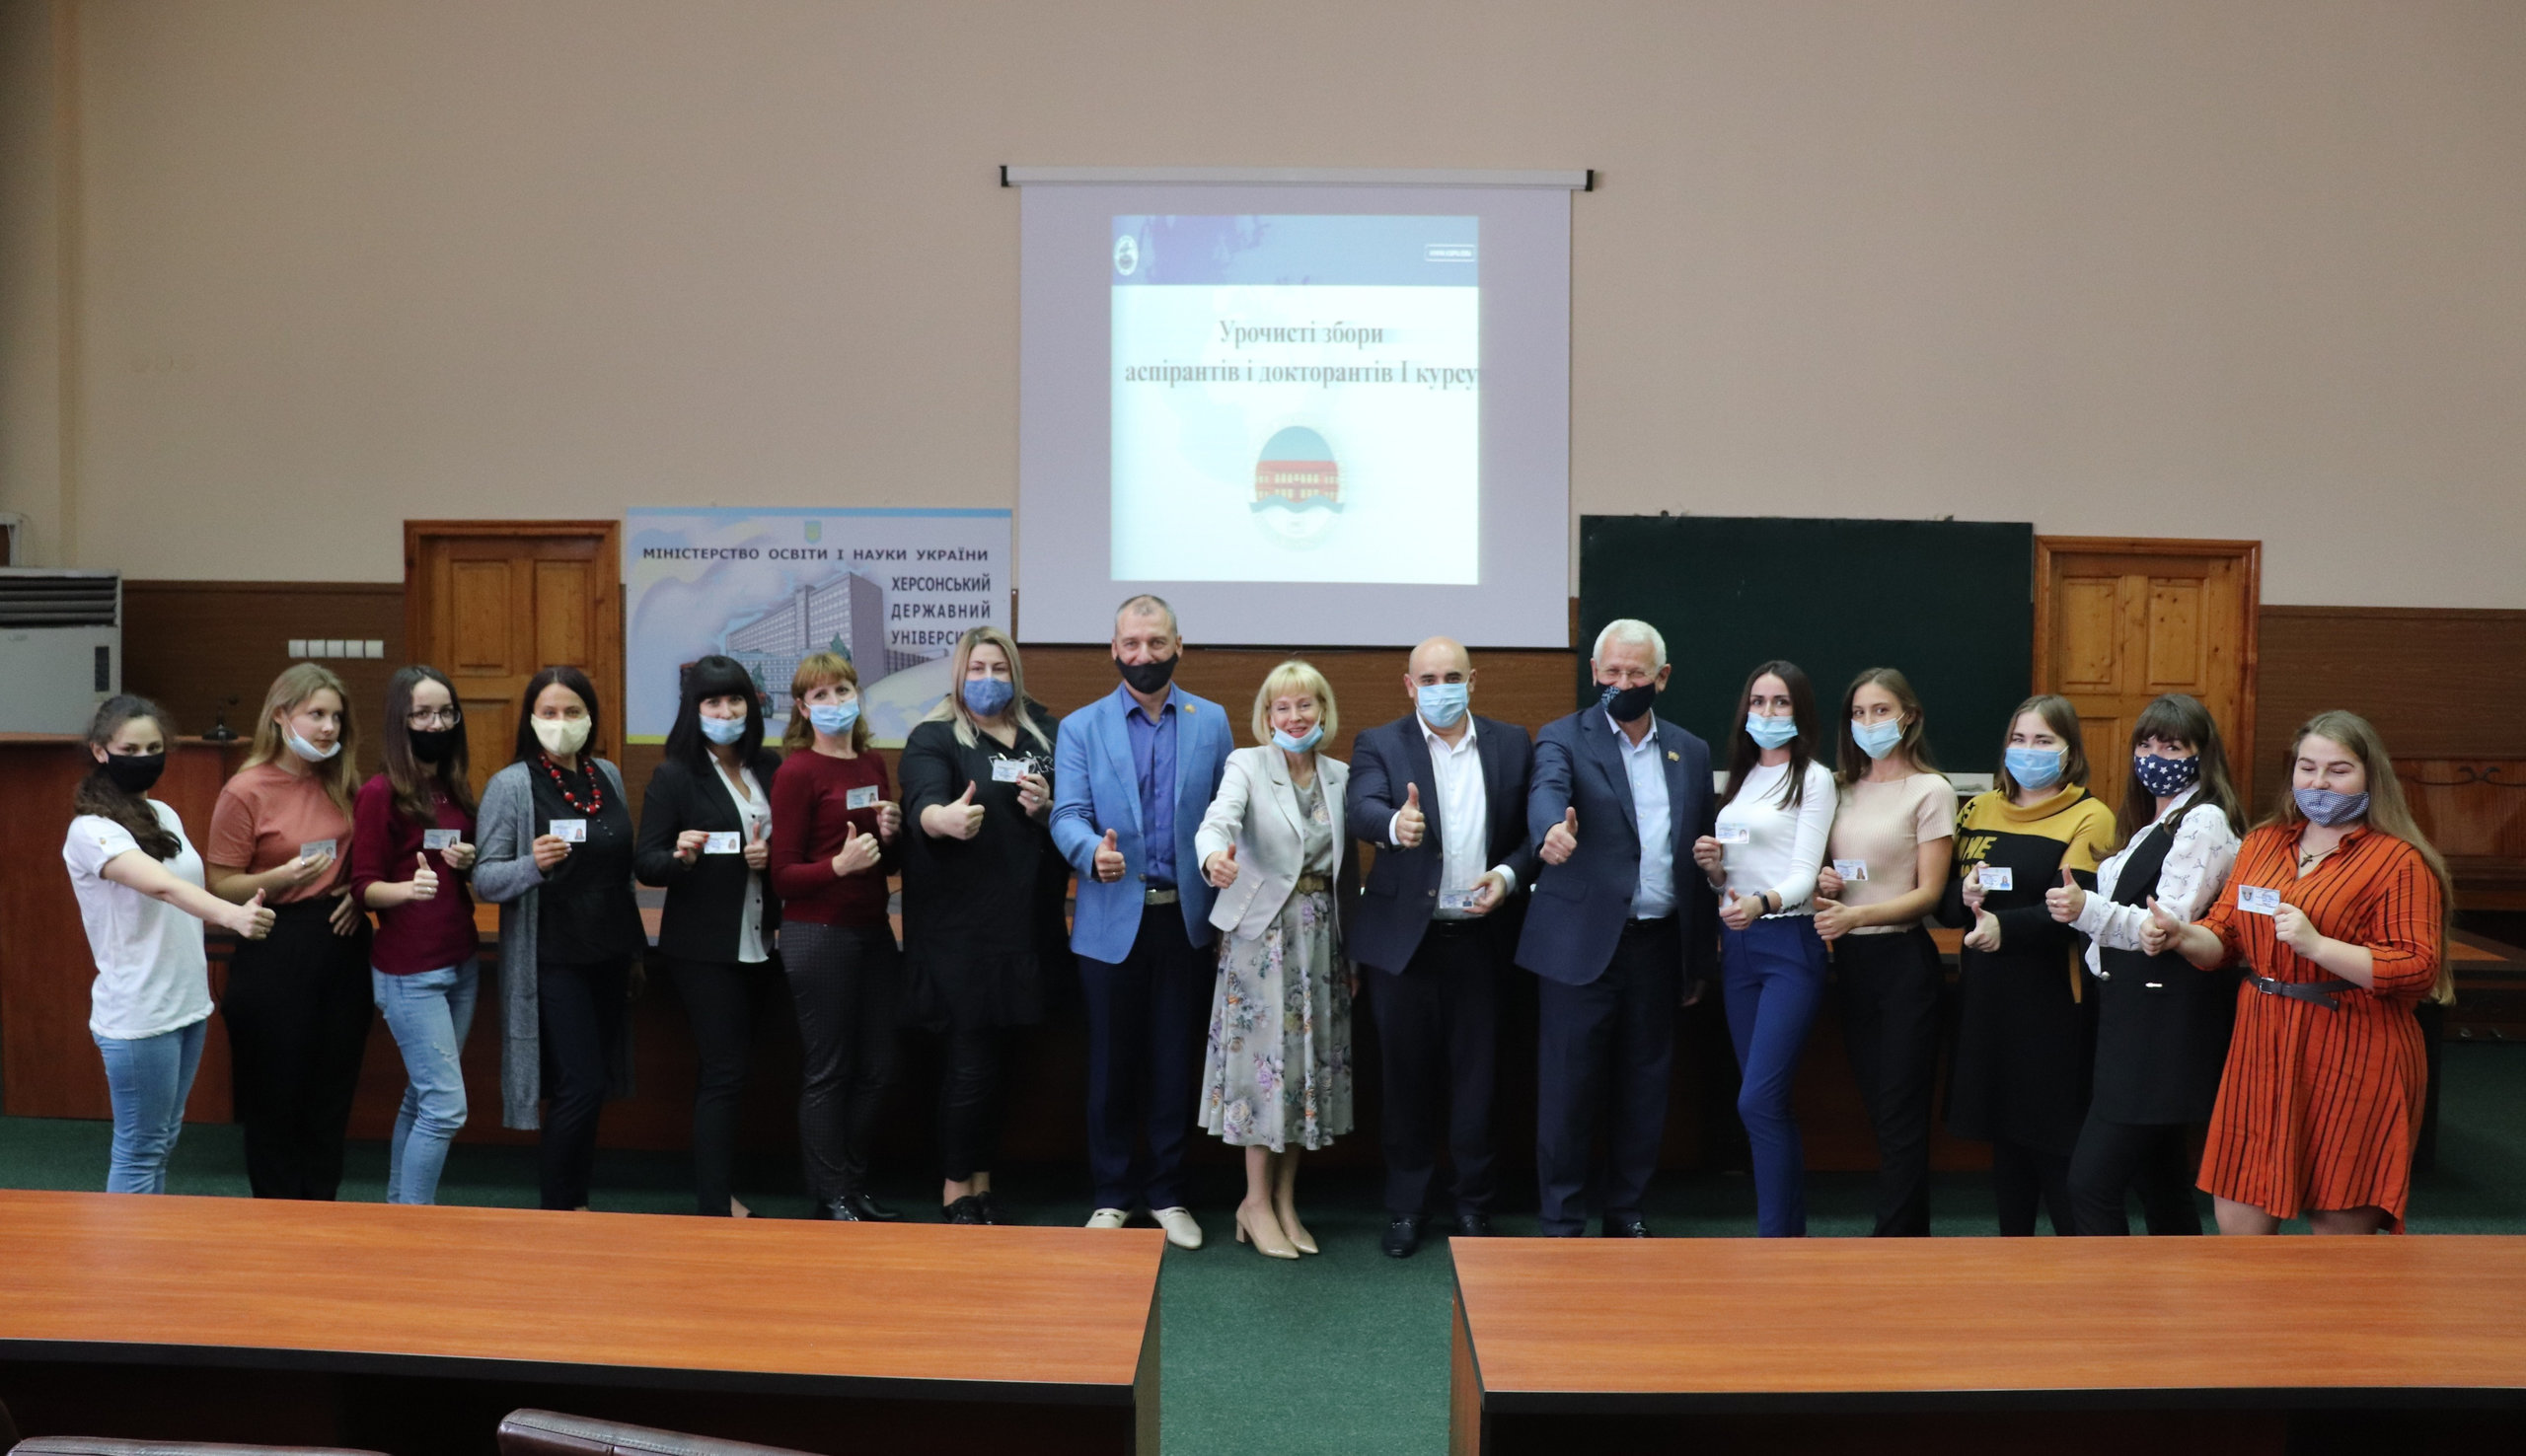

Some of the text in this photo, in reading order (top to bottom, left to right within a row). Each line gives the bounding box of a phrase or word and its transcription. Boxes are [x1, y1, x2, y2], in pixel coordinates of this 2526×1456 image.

[1219, 320, 1384, 350] Урочисті збори
[1125, 359, 1240, 389] аспірантів
[1247, 359, 1253, 382] і
[1258, 360, 1394, 390] докторантів
[1416, 367, 1478, 391] курсу
[642, 547, 989, 561] МІНІСТЕРСТВО ОСВІТИ І НАУКИ УКРАЇНИ
[891, 573, 991, 592] ХЕРСОНСЬКИЙ
[891, 600, 991, 620] ДЕРЖАВНИЙ
